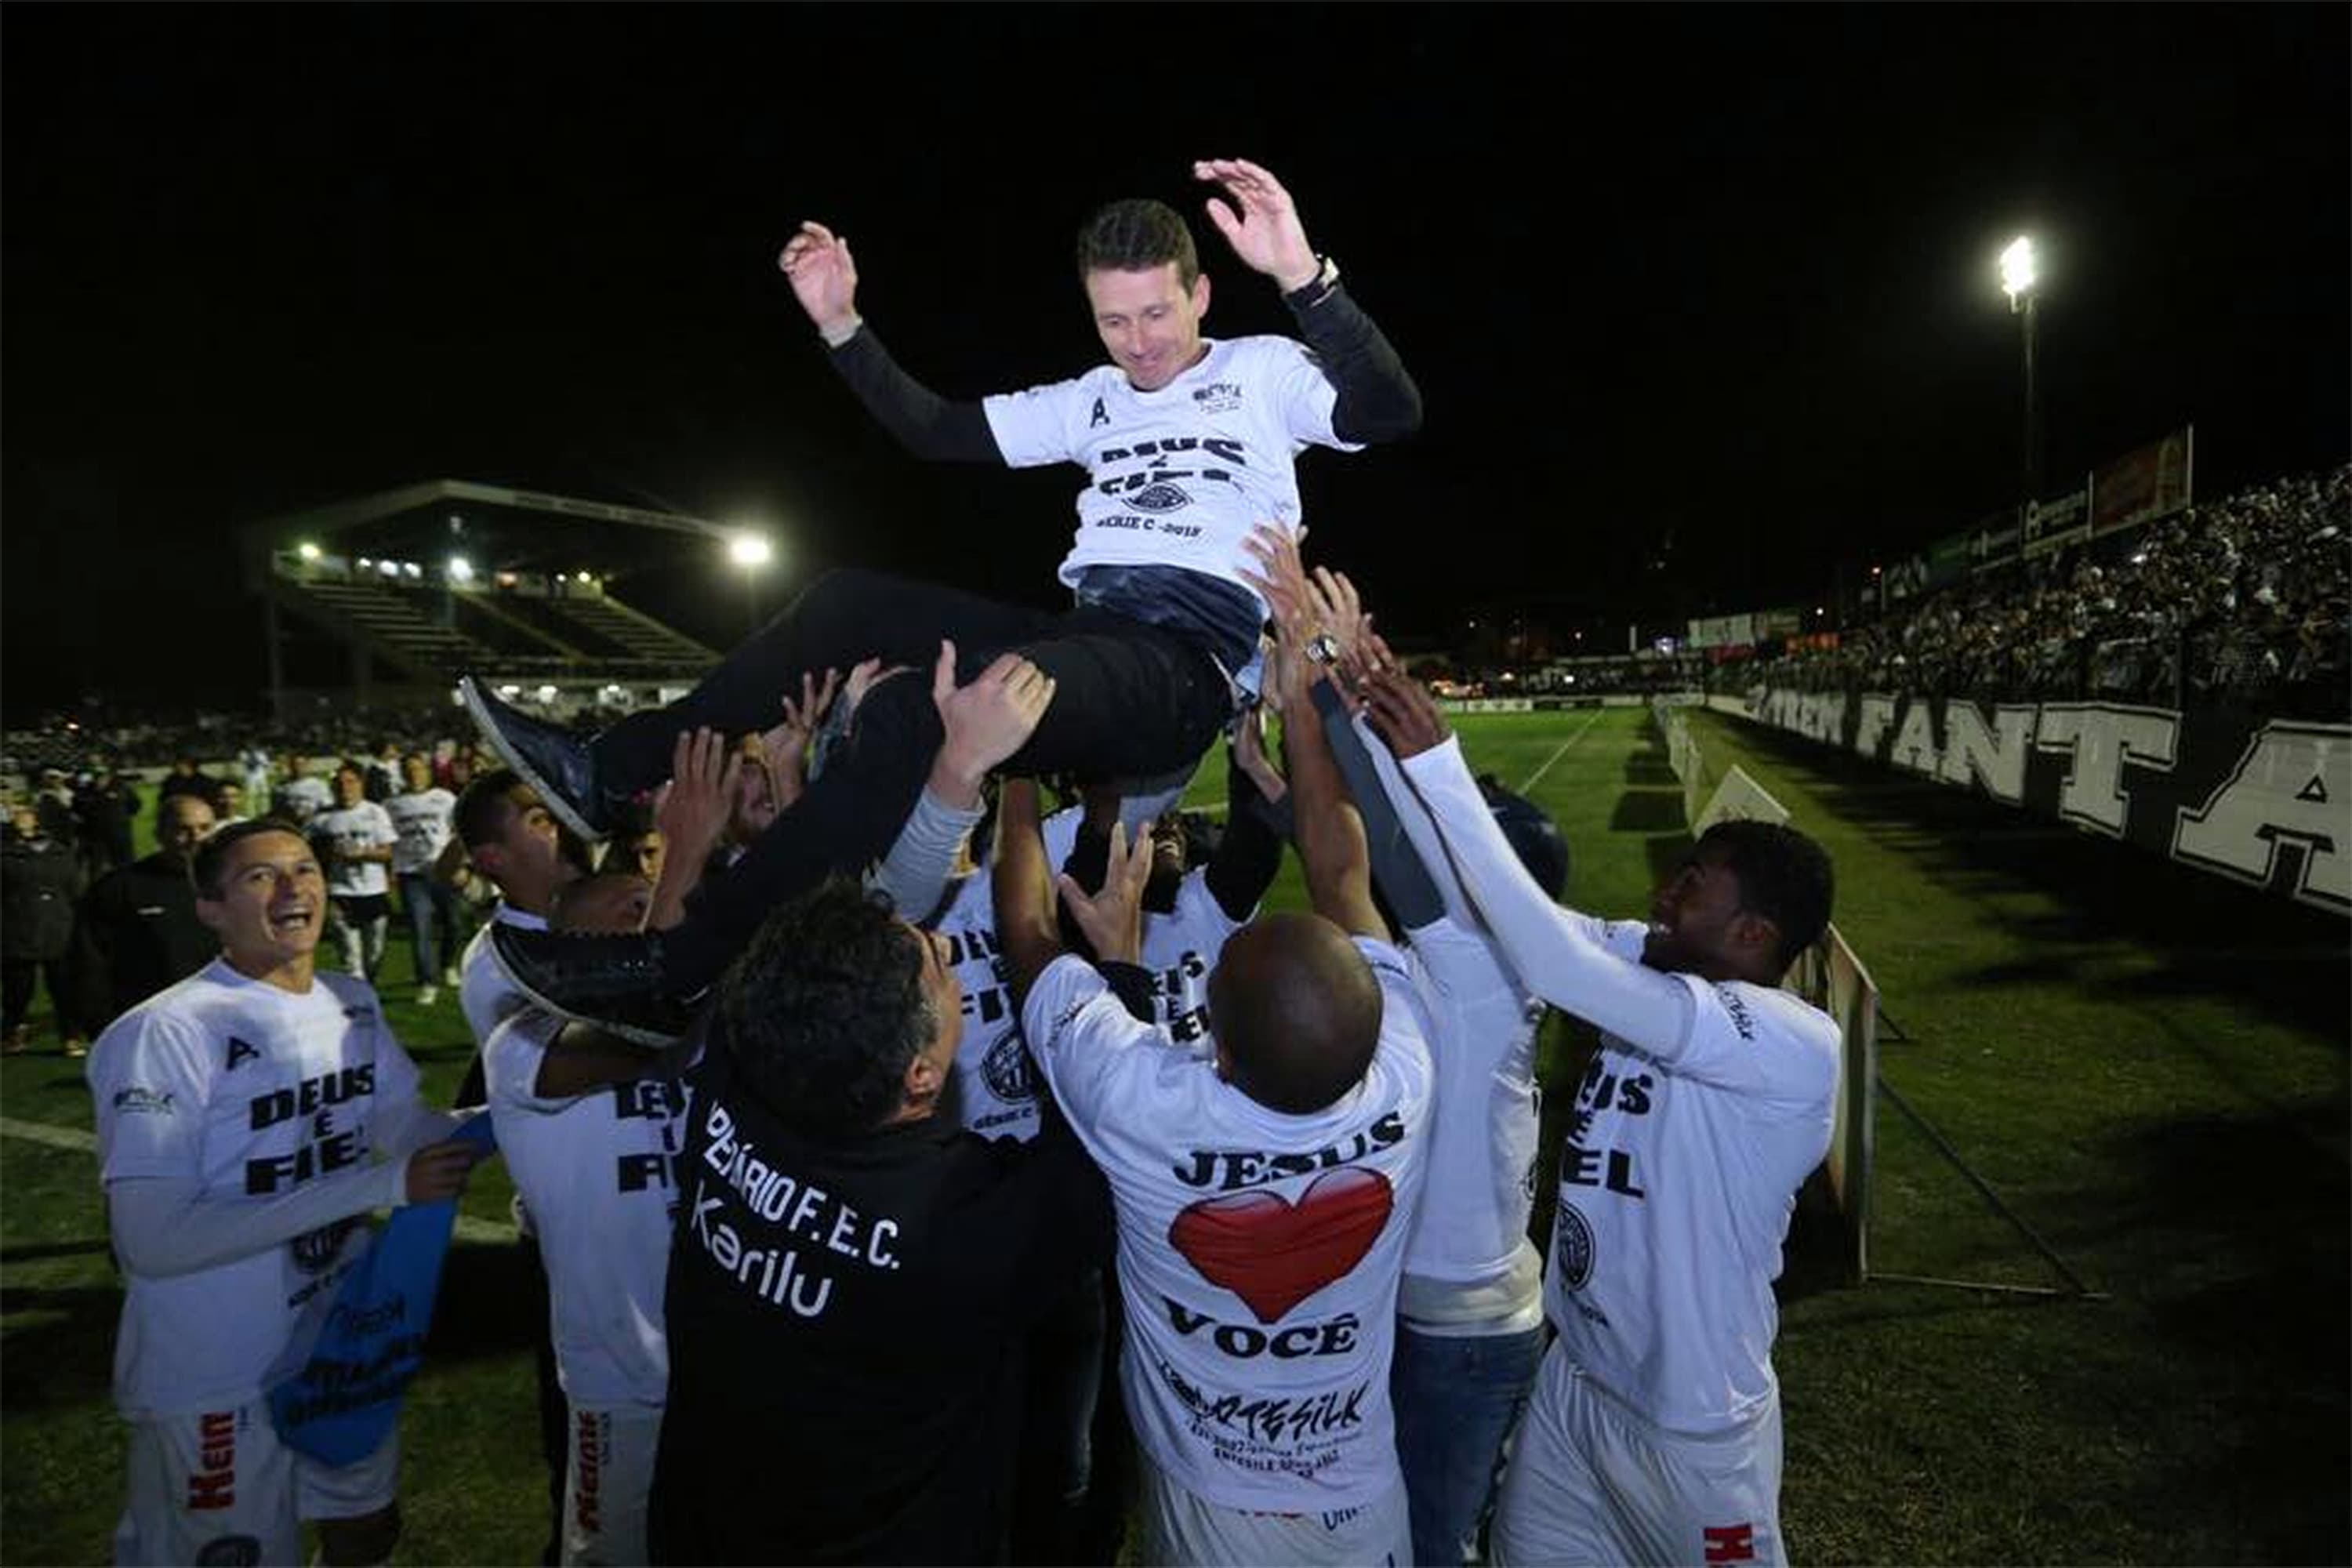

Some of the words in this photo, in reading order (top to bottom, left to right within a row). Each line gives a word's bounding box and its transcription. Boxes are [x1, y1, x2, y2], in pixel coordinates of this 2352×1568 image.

[250, 1063, 376, 1131] DEUS
[1173, 1110, 1405, 1190] JESUS
[691, 1179, 833, 1318] Karilu
[1160, 1295, 1360, 1359] VOCÊ
